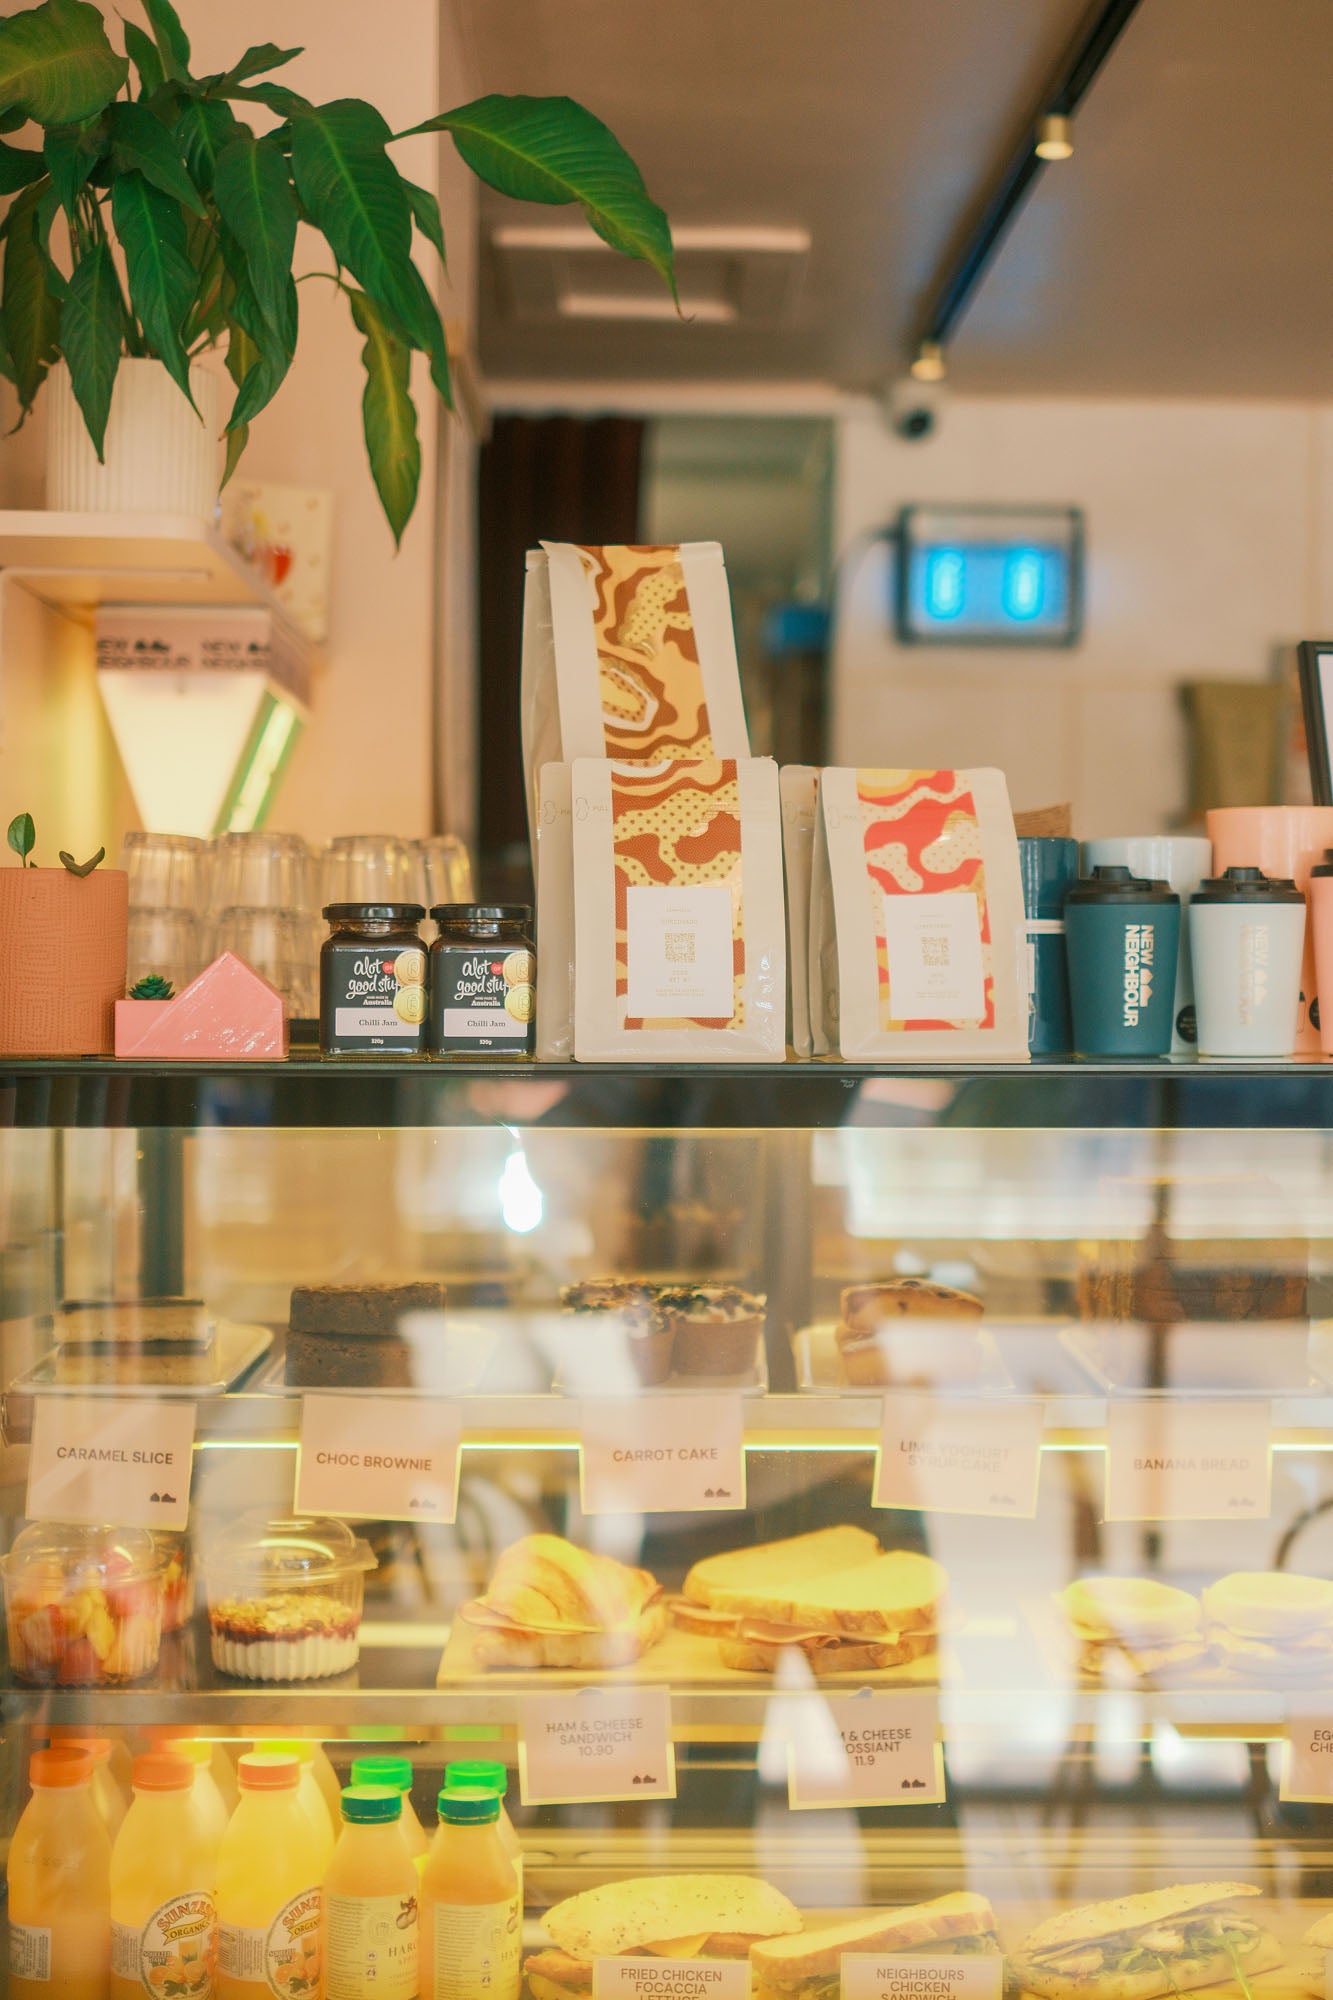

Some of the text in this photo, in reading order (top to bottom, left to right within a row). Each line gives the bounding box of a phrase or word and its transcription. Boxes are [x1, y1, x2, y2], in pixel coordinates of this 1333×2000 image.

[1141, 924, 1155, 966] NEW
[1123, 924, 1140, 1027] NEIGHBOUR
[345, 974, 402, 1000] good stuf
[454, 975, 511, 1001] good stuf
[358, 1019, 380, 1027] Chilli
[466, 1019, 507, 1028] Chilli Jam
[900, 1439, 936, 1455] LIME
[56, 1446, 174, 1465] CARAMEL SLICE
[316, 1452, 433, 1472] CHOC BROWNIE
[612, 1447, 720, 1463] CARROT CAKE
[961, 1458, 1001, 1473] CAKE
[1133, 1457, 1250, 1471] BANANA BREAD
[545, 1718, 643, 1733] HAM & CHEESE
[560, 1731, 632, 1745] SANDWICH
[849, 1730, 858, 1742] &
[862, 1728, 913, 1741] CHEESE
[1314, 1729, 1333, 1741] EG
[578, 1744, 614, 1757] 10.90
[845, 1741, 902, 1754] OSSIANT
[854, 1755, 875, 1766] 11.9
[157, 1899, 214, 1931] SUNZES
[620, 1968, 722, 1982] FRIED CHICKEN
[877, 1968, 965, 1981] NEIGHBOURS
[635, 1981, 707, 1994] FOCACCIA
[890, 1981, 951, 1993] CHICKEN
